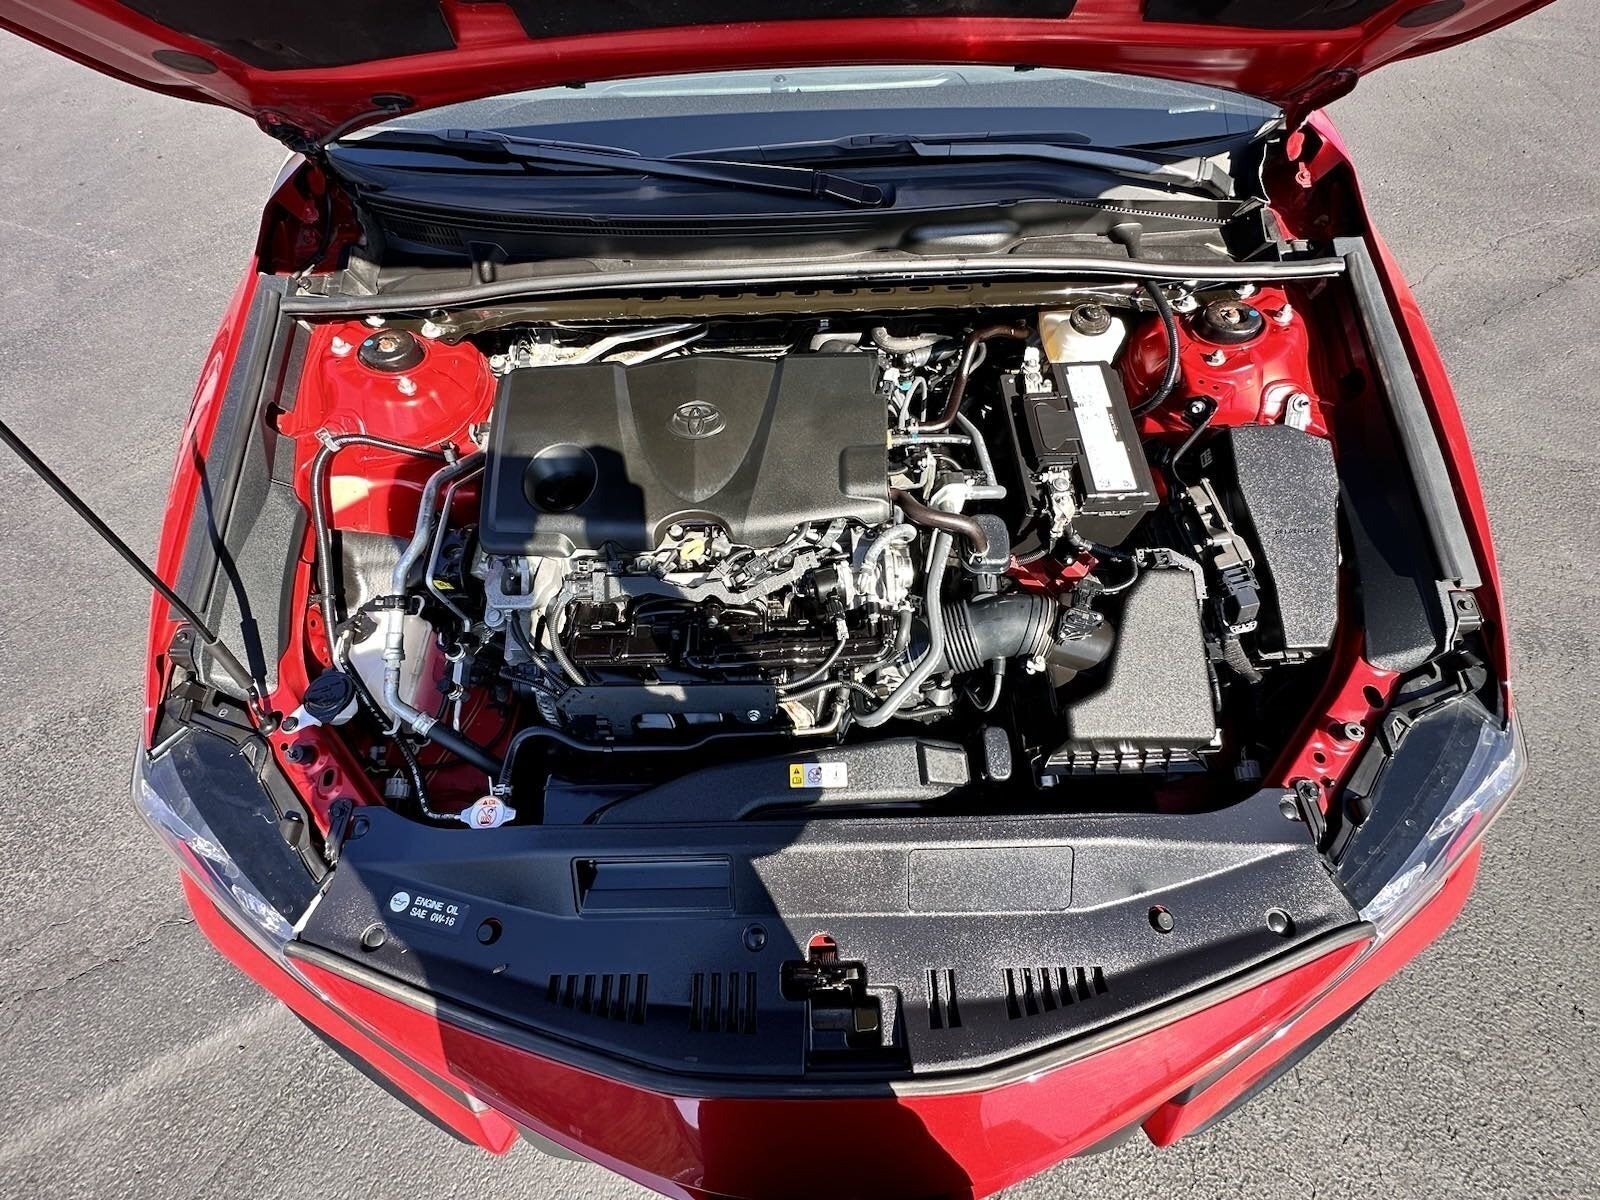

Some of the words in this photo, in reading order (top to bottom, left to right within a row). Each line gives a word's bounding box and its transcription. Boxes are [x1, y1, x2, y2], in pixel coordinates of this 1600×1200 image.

[409, 907, 428, 919] SAE
[414, 896, 445, 911] ENGINE
[446, 904, 459, 916] OIL
